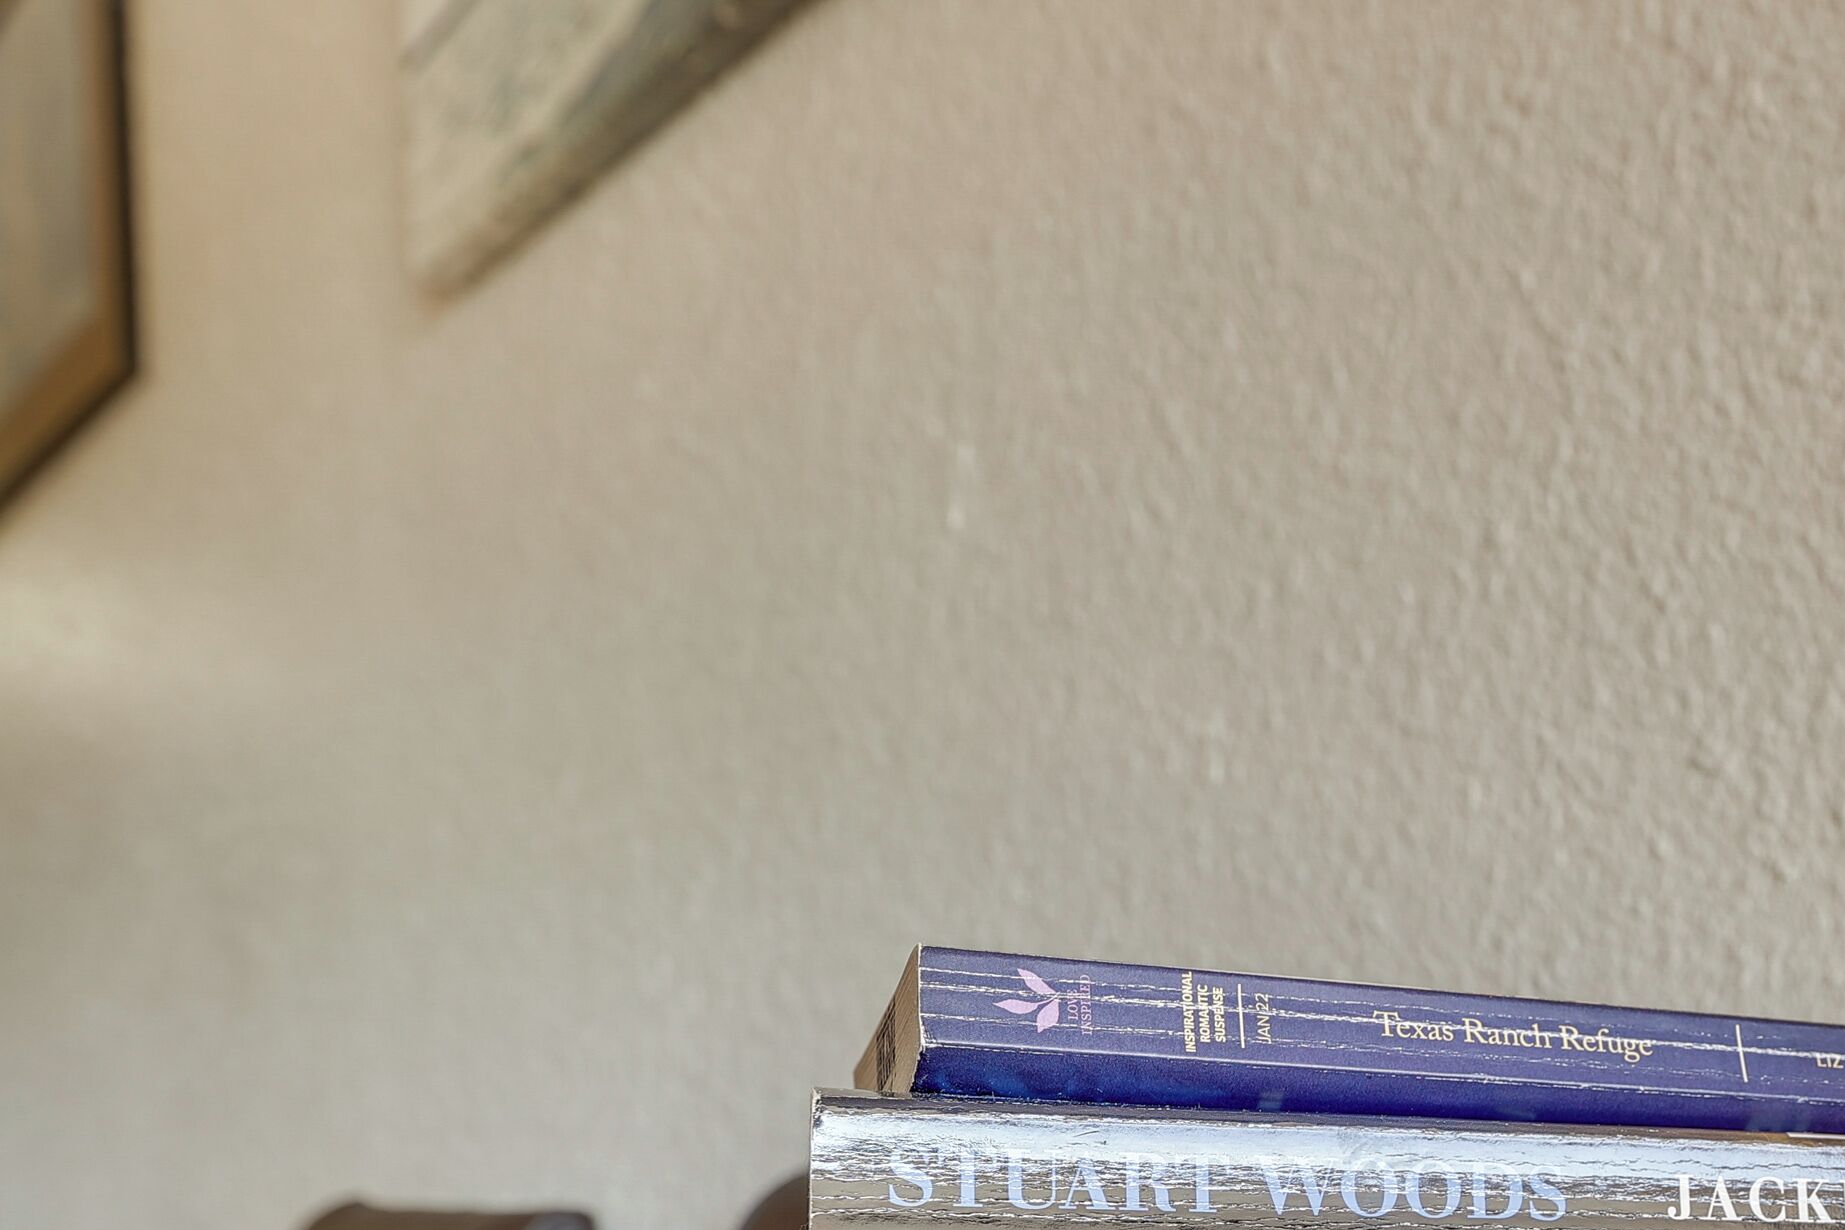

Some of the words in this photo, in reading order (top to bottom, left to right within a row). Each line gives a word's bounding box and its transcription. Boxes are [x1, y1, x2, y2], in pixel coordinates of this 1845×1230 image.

[1067, 989, 1079, 1020] LOVE
[1080, 975, 1093, 1035] INSPIRED
[1182, 971, 1196, 1053] INSPIRATIONAL
[1197, 984, 1211, 1042] ROMANTIC
[1213, 987, 1226, 1042] SUSPENSE
[1255, 993, 1269, 1014] 22
[1255, 1016, 1272, 1044] JAN
[1373, 1010, 1454, 1042] Texas
[1462, 1018, 1552, 1049] Ranch
[1559, 1025, 1653, 1062] Refuge
[1816, 1053, 1844, 1069] LIZ
[888, 1148, 1222, 1213] STUART
[1256, 1158, 1568, 1222] WOODS
